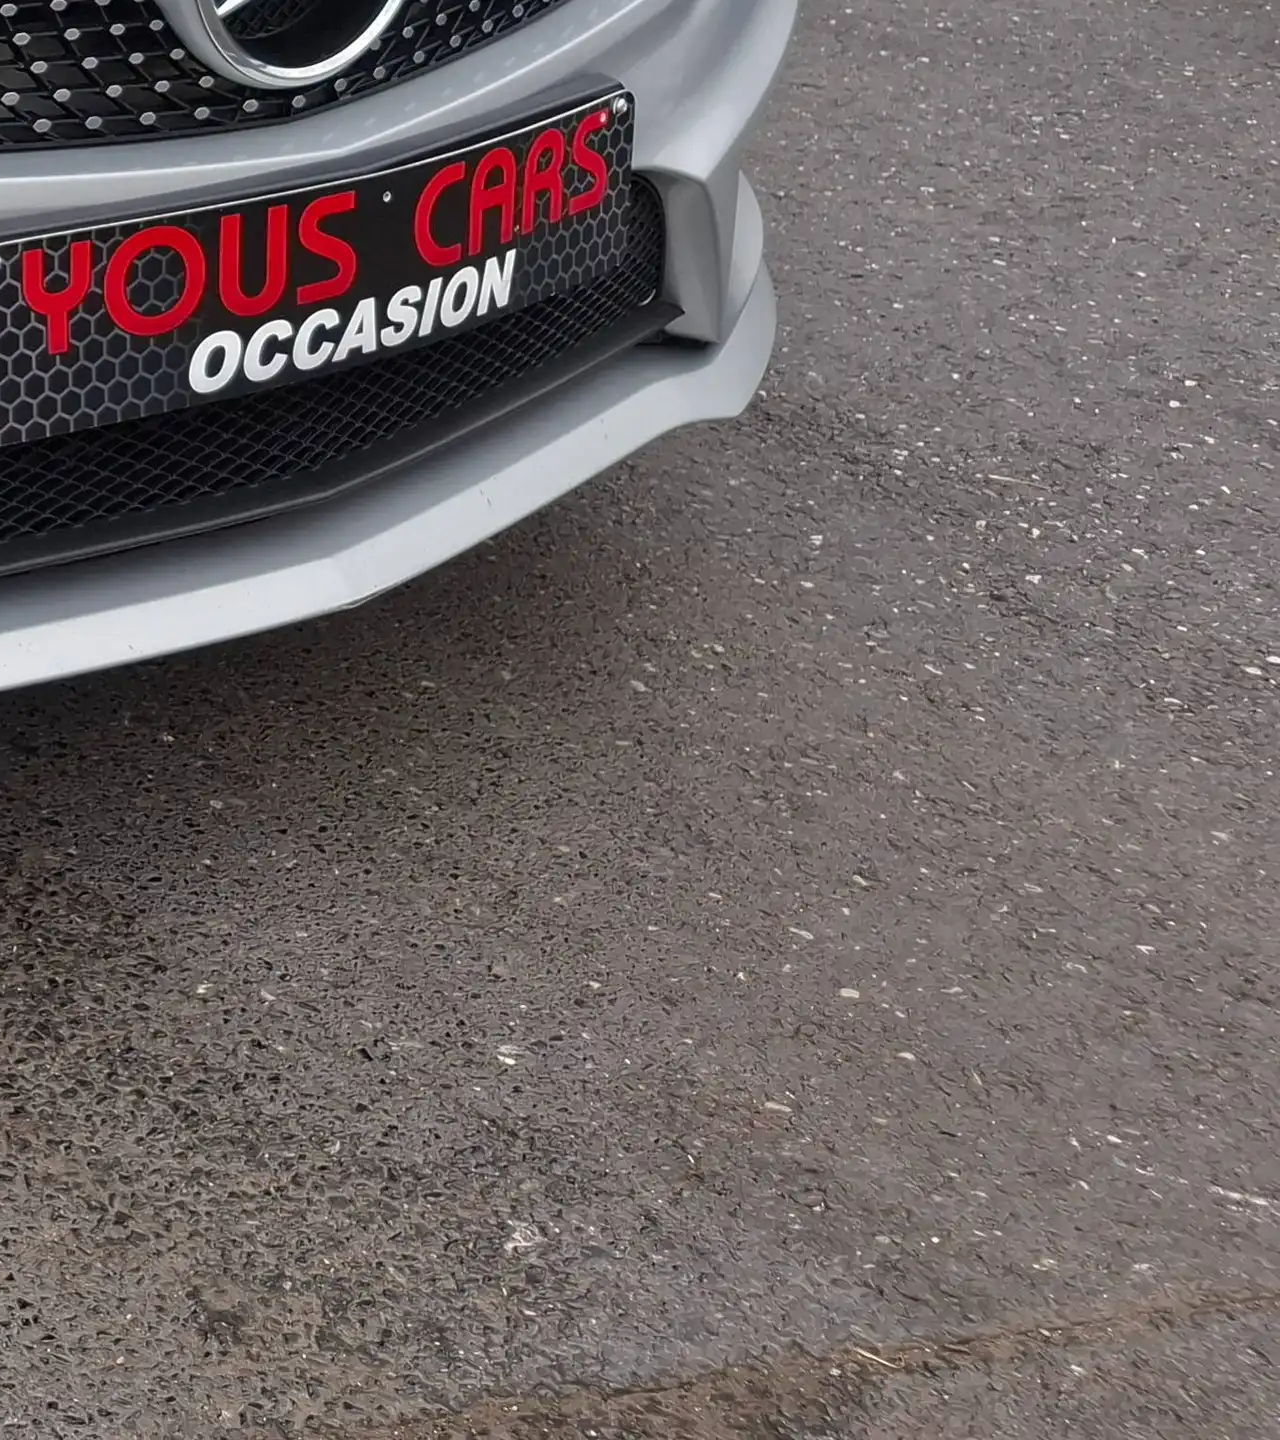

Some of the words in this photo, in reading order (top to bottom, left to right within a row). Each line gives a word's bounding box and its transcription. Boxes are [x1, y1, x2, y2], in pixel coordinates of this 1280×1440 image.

[21, 191, 358, 357] YOUS
[413, 111, 610, 268] CARS
[188, 248, 517, 394] OCCASION
